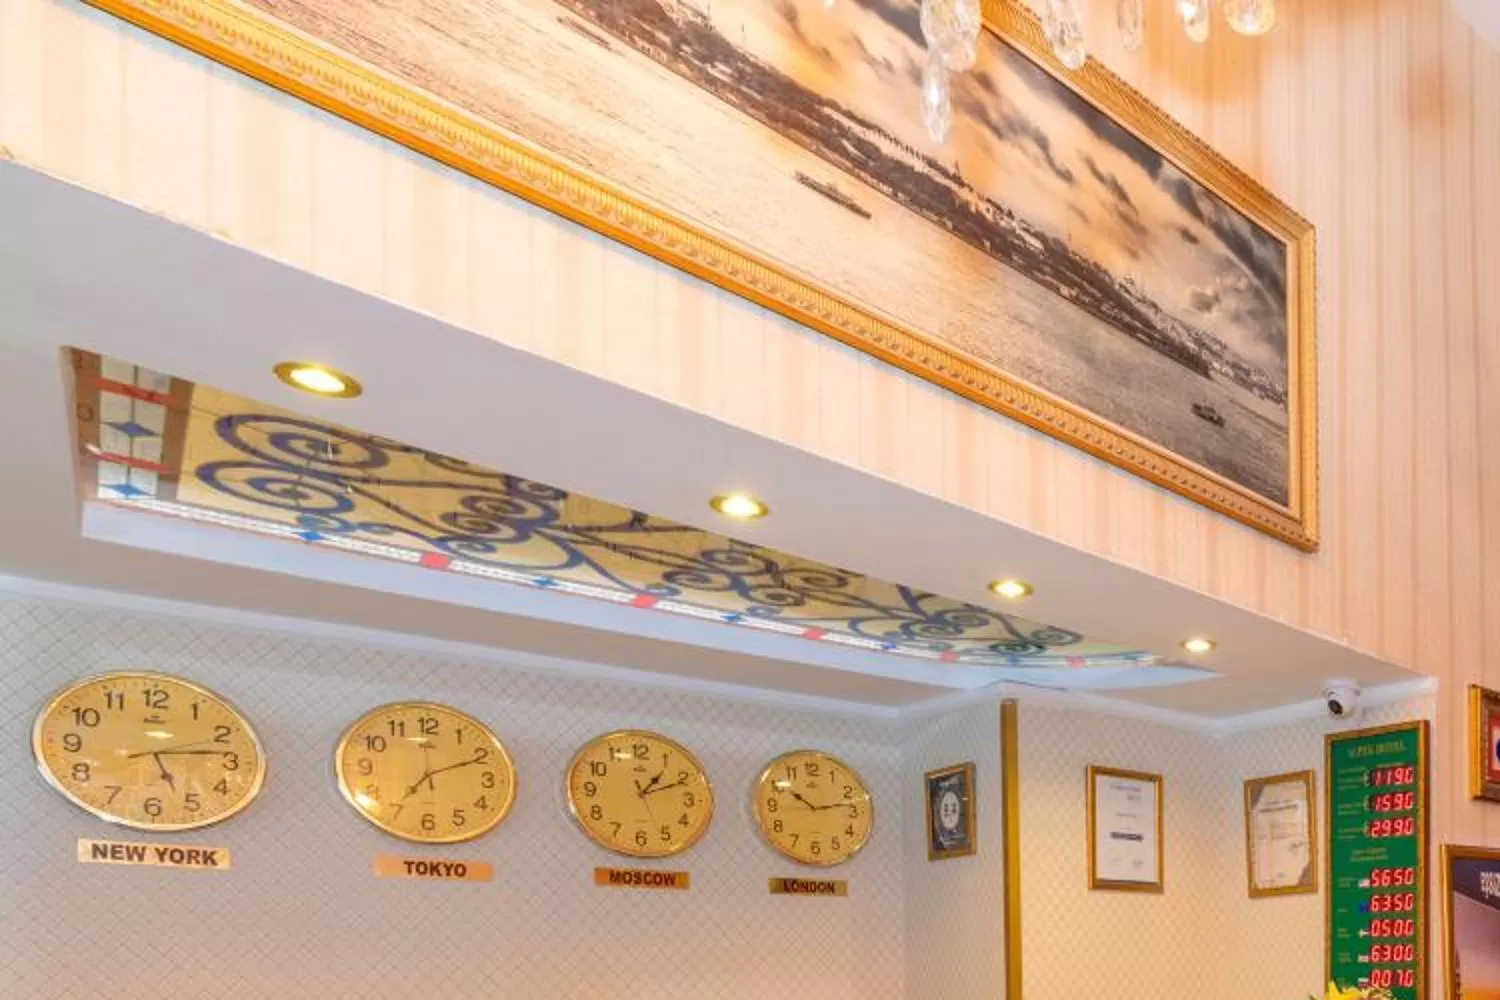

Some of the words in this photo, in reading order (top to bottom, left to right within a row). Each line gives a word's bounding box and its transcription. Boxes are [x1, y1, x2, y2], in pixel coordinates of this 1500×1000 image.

[104, 692, 124, 711] 11
[142, 689, 169, 709] 12
[72, 707, 100, 727] 10
[191, 703, 199, 720] 1
[214, 726, 231, 743] 2
[388, 720, 405, 737] 11
[418, 717, 439, 736] 12
[63, 733, 82, 753] 9
[365, 735, 386, 753] 10
[455, 728, 463, 745] 1
[474, 747, 488, 764] 2
[632, 744, 649, 760] 12
[223, 752, 239, 771] 3
[358, 758, 373, 776] 9
[590, 760, 607, 777] 10
[662, 753, 668, 769] 1
[804, 762, 820, 777] 12
[72, 763, 90, 782] 8
[481, 771, 495, 789] 3
[677, 771, 689, 785] 2
[786, 766, 797, 781] 11
[829, 770, 835, 782] 1
[1375, 766, 1414, 786] 1190
[104, 786, 122, 805] 7
[213, 778, 229, 796] 4
[583, 781, 597, 797] 9
[843, 785, 853, 799] 2
[144, 797, 161, 817] 6
[184, 794, 200, 812] 5
[474, 796, 488, 810] 4
[683, 792, 694, 808] 3
[767, 798, 778, 812] 9
[1375, 791, 1414, 811] 1590
[390, 803, 405, 820] 7
[452, 809, 465, 826] 5
[590, 805, 602, 821] 8
[848, 803, 859, 819] 3
[421, 813, 435, 830] 6
[677, 813, 689, 828] 4
[773, 819, 783, 833] 8
[1371, 817, 1414, 838] 2990
[608, 821, 622, 838] 7
[660, 826, 671, 841] 5
[845, 823, 854, 838] 4
[635, 830, 647, 847] 6
[789, 833, 800, 848] 7
[831, 836, 841, 850] 5
[91, 843, 147, 863] NEW
[153, 847, 218, 867] YORK
[810, 841, 821, 855] 6
[403, 860, 468, 878] TOKYO
[1371, 867, 1414, 887] 5650
[609, 870, 676, 886] MOSCOW
[783, 879, 835, 893] LONDON
[1371, 893, 1414, 912] 6350
[1371, 919, 1414, 937] 0500
[1371, 944, 1414, 962] 6300
